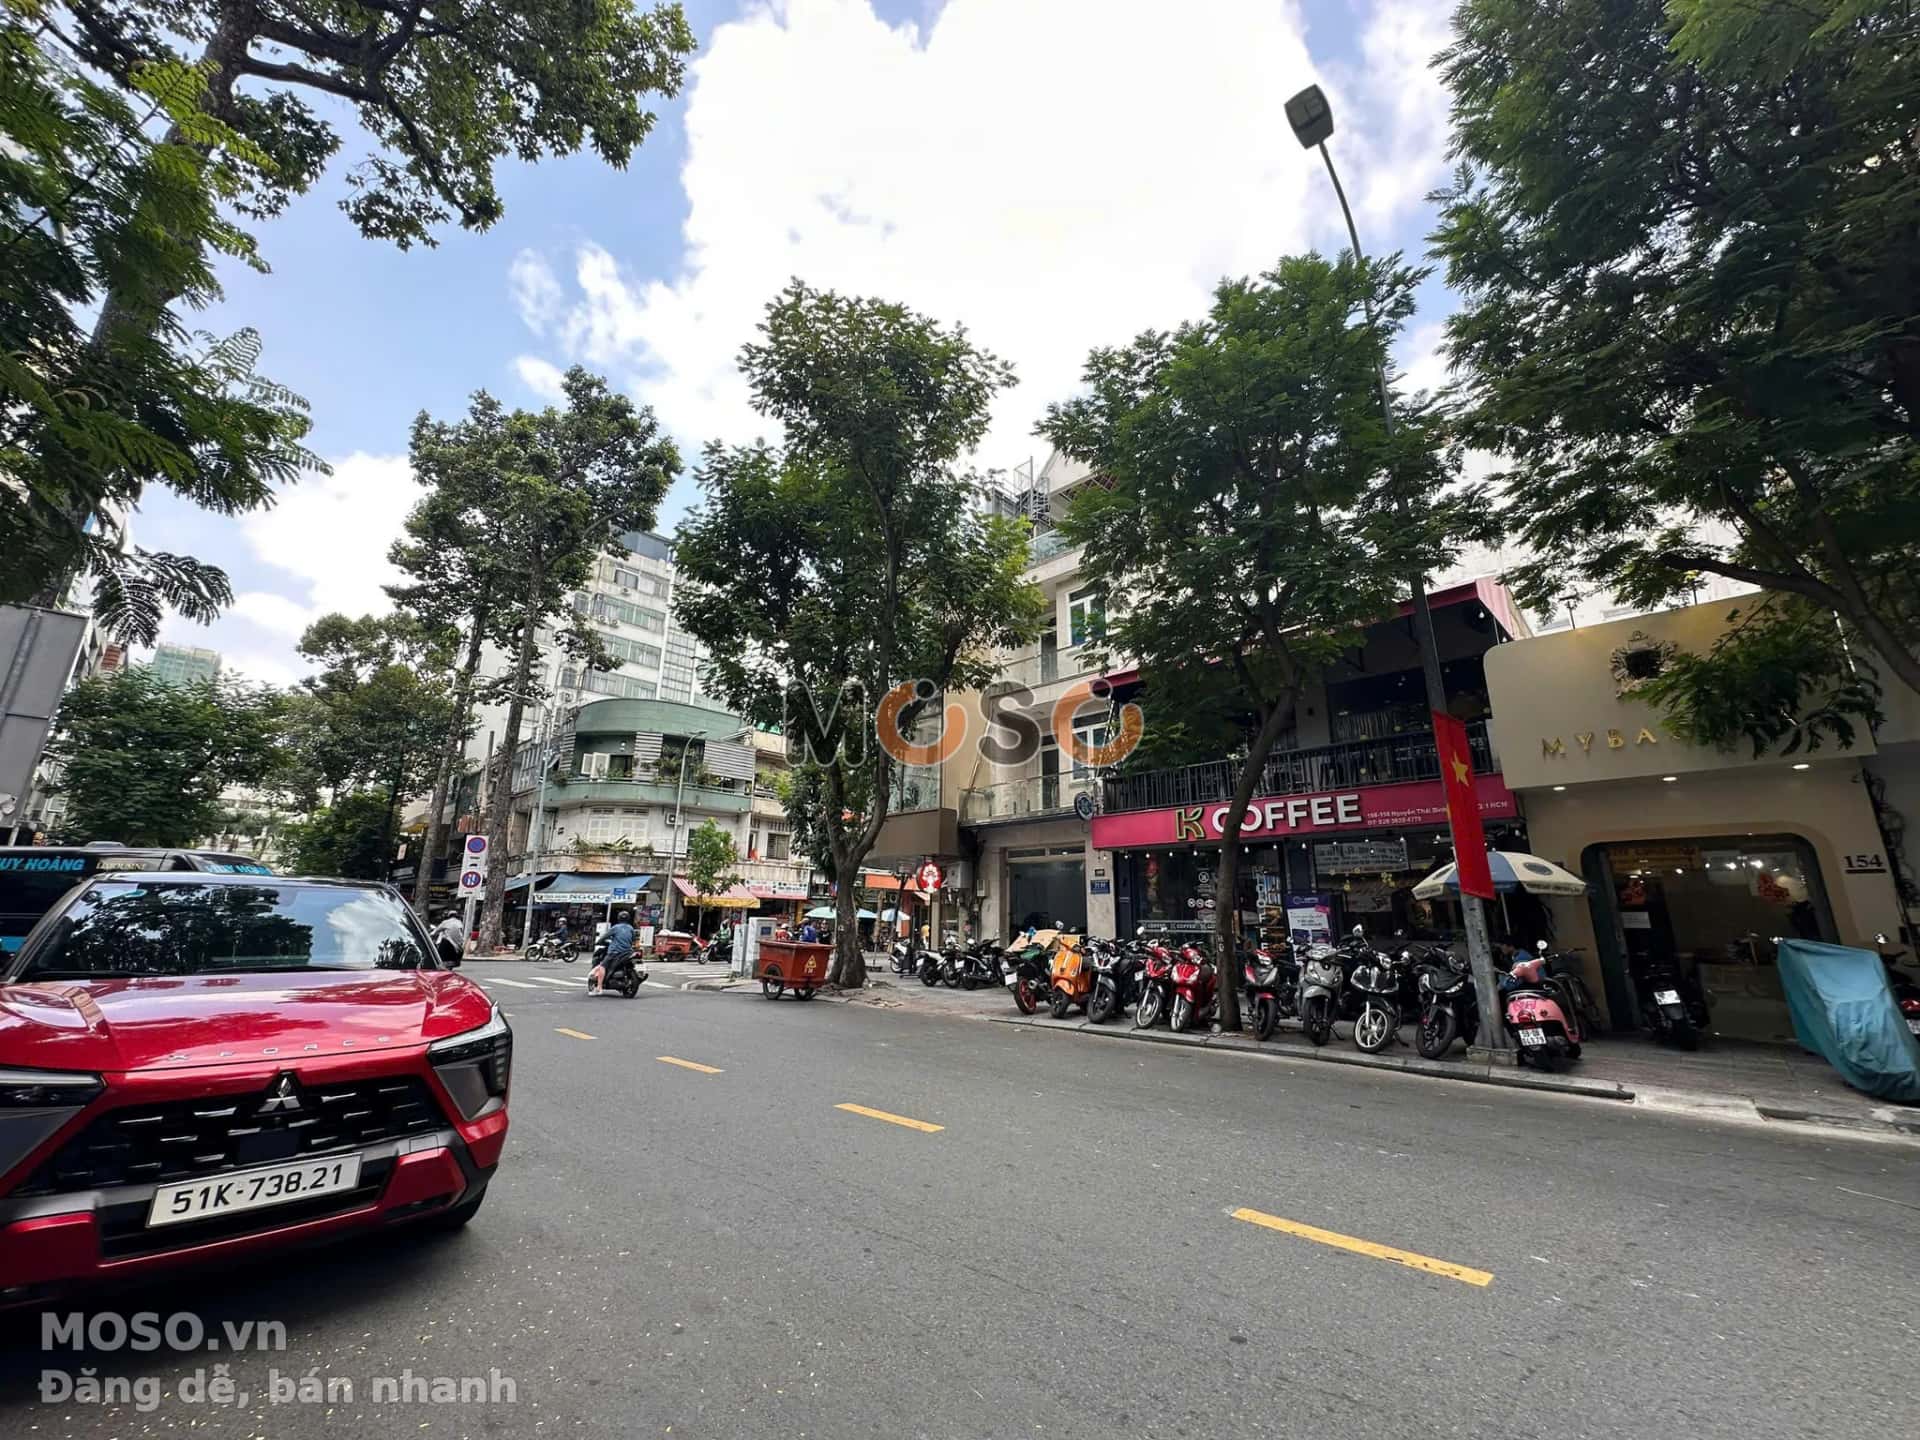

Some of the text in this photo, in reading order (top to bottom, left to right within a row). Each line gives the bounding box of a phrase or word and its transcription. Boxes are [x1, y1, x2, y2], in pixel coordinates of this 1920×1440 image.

[1541, 727, 1681, 758] MYBA
[1175, 794, 1362, 840] K COFFEE
[0, 855, 86, 872] UY HOÀNG
[1844, 853, 1884, 869] 154
[171, 1162, 344, 1216] 51K-738.21
